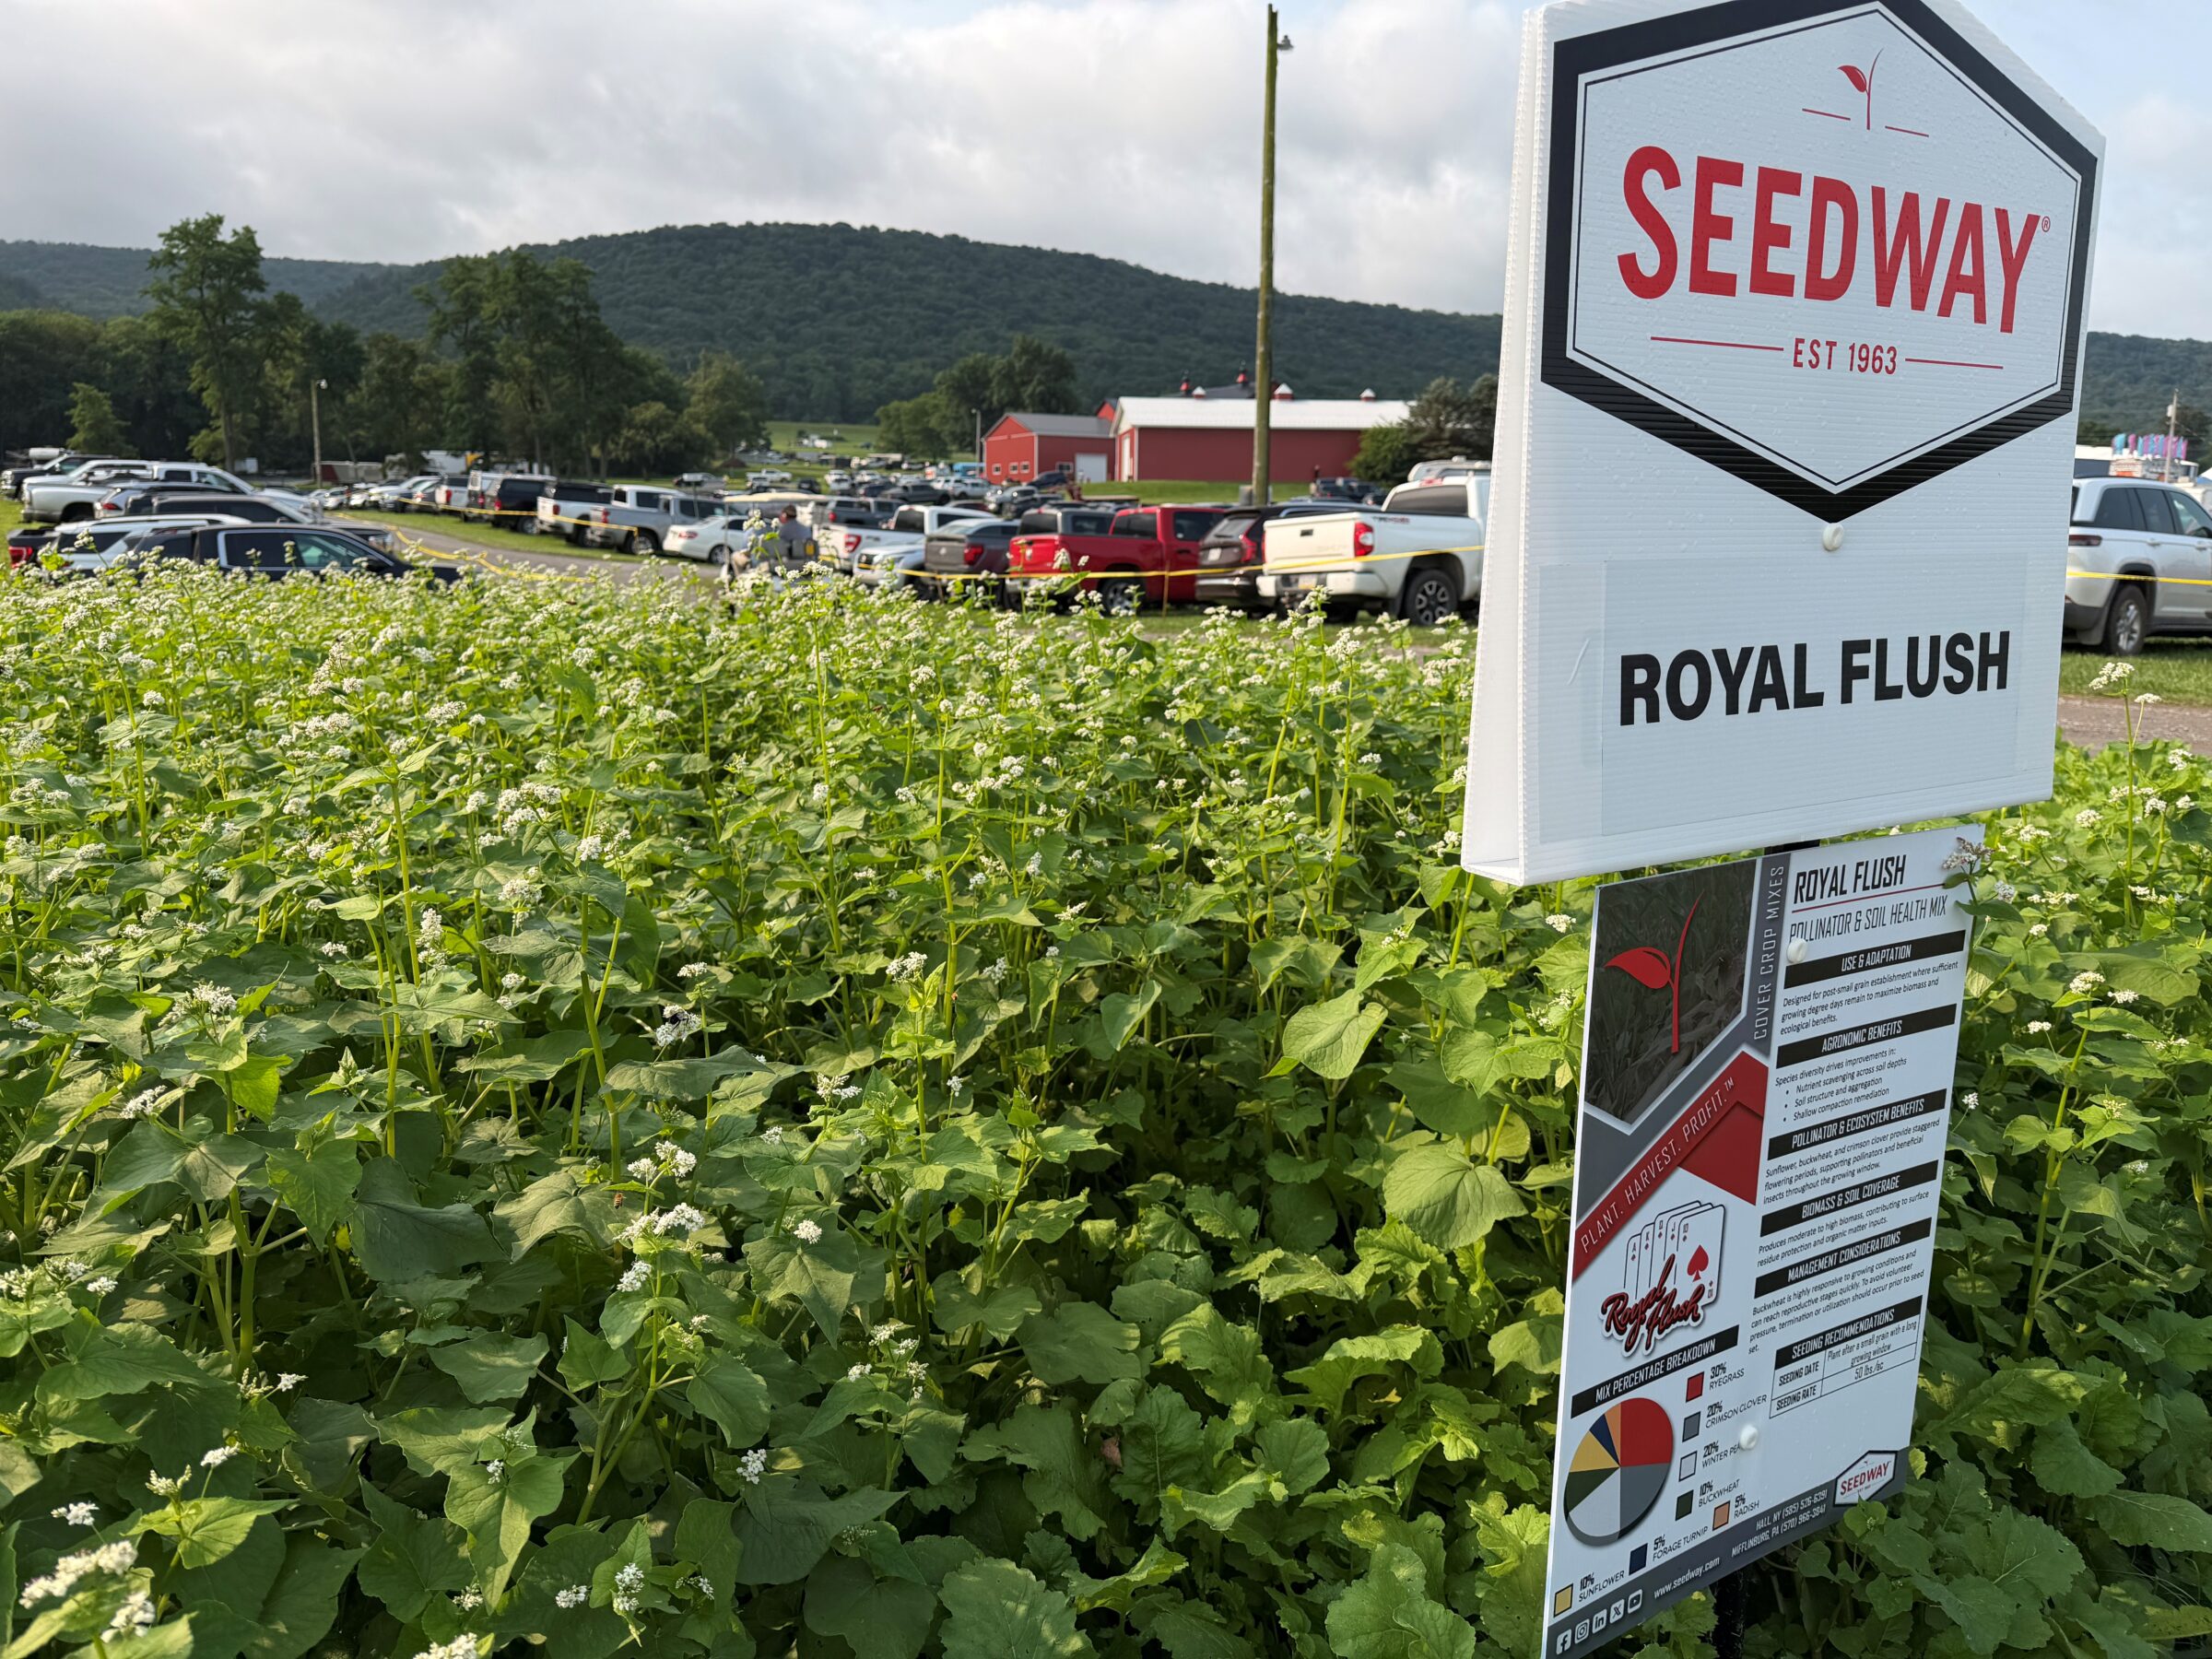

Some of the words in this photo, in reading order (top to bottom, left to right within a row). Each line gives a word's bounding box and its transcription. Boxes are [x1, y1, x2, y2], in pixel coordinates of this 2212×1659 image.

[1793, 337, 1837, 371] EST
[1848, 343, 1898, 376] 1963
[1619, 643, 1826, 726] ROYAL
[1840, 629, 2012, 705] FLUSH
[1766, 866, 1783, 919] MIXES
[1794, 865, 1846, 903] ROYAL
[1853, 854, 1906, 892] FLUSH
[1854, 911, 1861, 931] &
[1865, 906, 1886, 929] SOIL
[1889, 899, 1926, 924] HEALTH
[1929, 895, 1947, 916] MIX
[1760, 928, 1776, 974] CROP
[1841, 955, 1856, 971] USE
[1858, 954, 1864, 967] &
[1865, 944, 1911, 966] ADAPTATION
[1782, 1008, 1806, 1022] growing
[1807, 1004, 1828, 1014] degree
[1830, 1000, 1842, 1008] days
[1844, 994, 1865, 1005] remain
[1874, 987, 1901, 998] maximize
[1902, 981, 1926, 992] biomass
[1927, 978, 1938, 986] and
[1783, 992, 1811, 1006] Designed
[1813, 990, 1821, 999] for
[1822, 982, 1853, 998] post-small
[1853, 980, 1868, 992] grain
[1870, 971, 1911, 985] establishment
[1912, 968, 1930, 976] where
[1932, 961, 1958, 972] sufficient
[1754, 982, 1771, 1039] COVER
[1780, 1019, 1810, 1034] ecological
[1812, 1014, 1837, 1027] benefits.
[1821, 1029, 1865, 1052] AGRONOMIC
[1867, 1019, 1901, 1040] BENEFITS
[1775, 1074, 1797, 1086] Species
[1799, 1066, 1824, 1078] diversity
[1826, 1062, 1843, 1071] drives
[1845, 1051, 1887, 1066] improvements
[1796, 1080, 1821, 1092] Nutrient
[1822, 1071, 1854, 1086] scavenging
[1856, 1066, 1874, 1077] across
[1876, 1061, 1886, 1071] soil
[1887, 1057, 1906, 1068] depths
[1794, 1096, 1806, 1107] Soil
[1806, 1090, 1833, 1103] structure
[1835, 1085, 1846, 1095] and
[1848, 1077, 1881, 1092] aggregation
[1794, 1108, 1817, 1120] Shallow
[1818, 1098, 1852, 1112] compaction
[1853, 1088, 1888, 1102] remediation
[1792, 1123, 1837, 1147] POLLINATOR
[1839, 1121, 1844, 1134] &
[1846, 1108, 1889, 1132] ECOSYSTEM
[1890, 1099, 1924, 1119] BENEFITS
[1766, 1162, 1796, 1177] Sunflower,
[1798, 1150, 1832, 1166] buckwheat,
[1834, 1145, 1845, 1155] and
[1846, 1139, 1869, 1151] crimson
[1871, 1134, 1888, 1144] clover
[1889, 1126, 1911, 1140] provide
[1912, 1119, 1939, 1133] staggered
[1581, 1202, 1622, 1253] PLANT.
[1625, 1138, 1680, 1204] HARVEST.
[1763, 1192, 1783, 1204] insects
[1785, 1180, 1818, 1196] throughout
[1820, 1176, 1830, 1185] the
[1831, 1169, 1854, 1183] growing
[1856, 1162, 1879, 1173] window.
[1802, 1195, 1835, 1218] BIOMASS
[1837, 1194, 1842, 1206] &
[1844, 1188, 1859, 1204] SOIL
[1862, 1175, 1900, 1197] COVERAGE
[1759, 1239, 1785, 1253] Produces
[1787, 1228, 1816, 1242] moderate
[1825, 1219, 1837, 1230] high
[1839, 1212, 1864, 1225] biomass,
[1865, 1200, 1900, 1216] contributing
[1909, 1191, 1928, 1203] surface
[1788, 1253, 1837, 1281] MANAGEMENT
[1839, 1230, 1900, 1263] CONSIDERATIONS
[1752, 1297, 1785, 1315] Buckwheat
[1793, 1288, 1810, 1299] highly
[1812, 1277, 1842, 1292] responsive
[1851, 1265, 1874, 1279] growing
[1876, 1254, 1904, 1269] conditions
[1905, 1249, 1916, 1259] and
[1601, 1253, 1676, 1352] Royal
[1792, 1335, 1823, 1359] SEEDING
[1824, 1309, 1894, 1345] RECOMMENDATIONS
[1595, 1383, 1610, 1402] MIX
[1613, 1359, 1665, 1394] PERCENTAGE
[1666, 1338, 1715, 1370] BREAKDOWN
[1710, 1368, 1744, 1389] RYEGRASS
[1711, 1362, 1725, 1379] 30%
[1779, 1367, 1803, 1385] SEEDING
[1805, 1360, 1818, 1375] DATE
[1854, 1366, 1863, 1379] 50
[1705, 1406, 1737, 1428] CRIMSON
[1739, 1394, 1766, 1412] CLOVER
[1707, 1401, 1722, 1418] 20%
[1776, 1392, 1800, 1410] SEEDING
[1802, 1384, 1816, 1399] RATE
[1702, 1450, 1727, 1467] WINTER
[1703, 1441, 1718, 1457] 20%
[1699, 1478, 1739, 1507] BUCKWHEAT
[1700, 1481, 1712, 1496] 10%
[1735, 1494, 1745, 1508] 5%
[1772, 1511, 1781, 1522] NY
[1783, 1502, 1798, 1518] (585)
[1800, 1488, 1827, 1509] 526-6391
[1734, 1500, 1759, 1518] RADISH
[1653, 1535, 1665, 1550] 5%
[1653, 1539, 1681, 1560] FORAGE
[1683, 1525, 1707, 1544] TURNIP
[1579, 1570, 1624, 1602] SUNFLOWER
[1580, 1572, 1594, 1590] 10%
[1654, 1557, 1719, 1598] www.seedway.com
